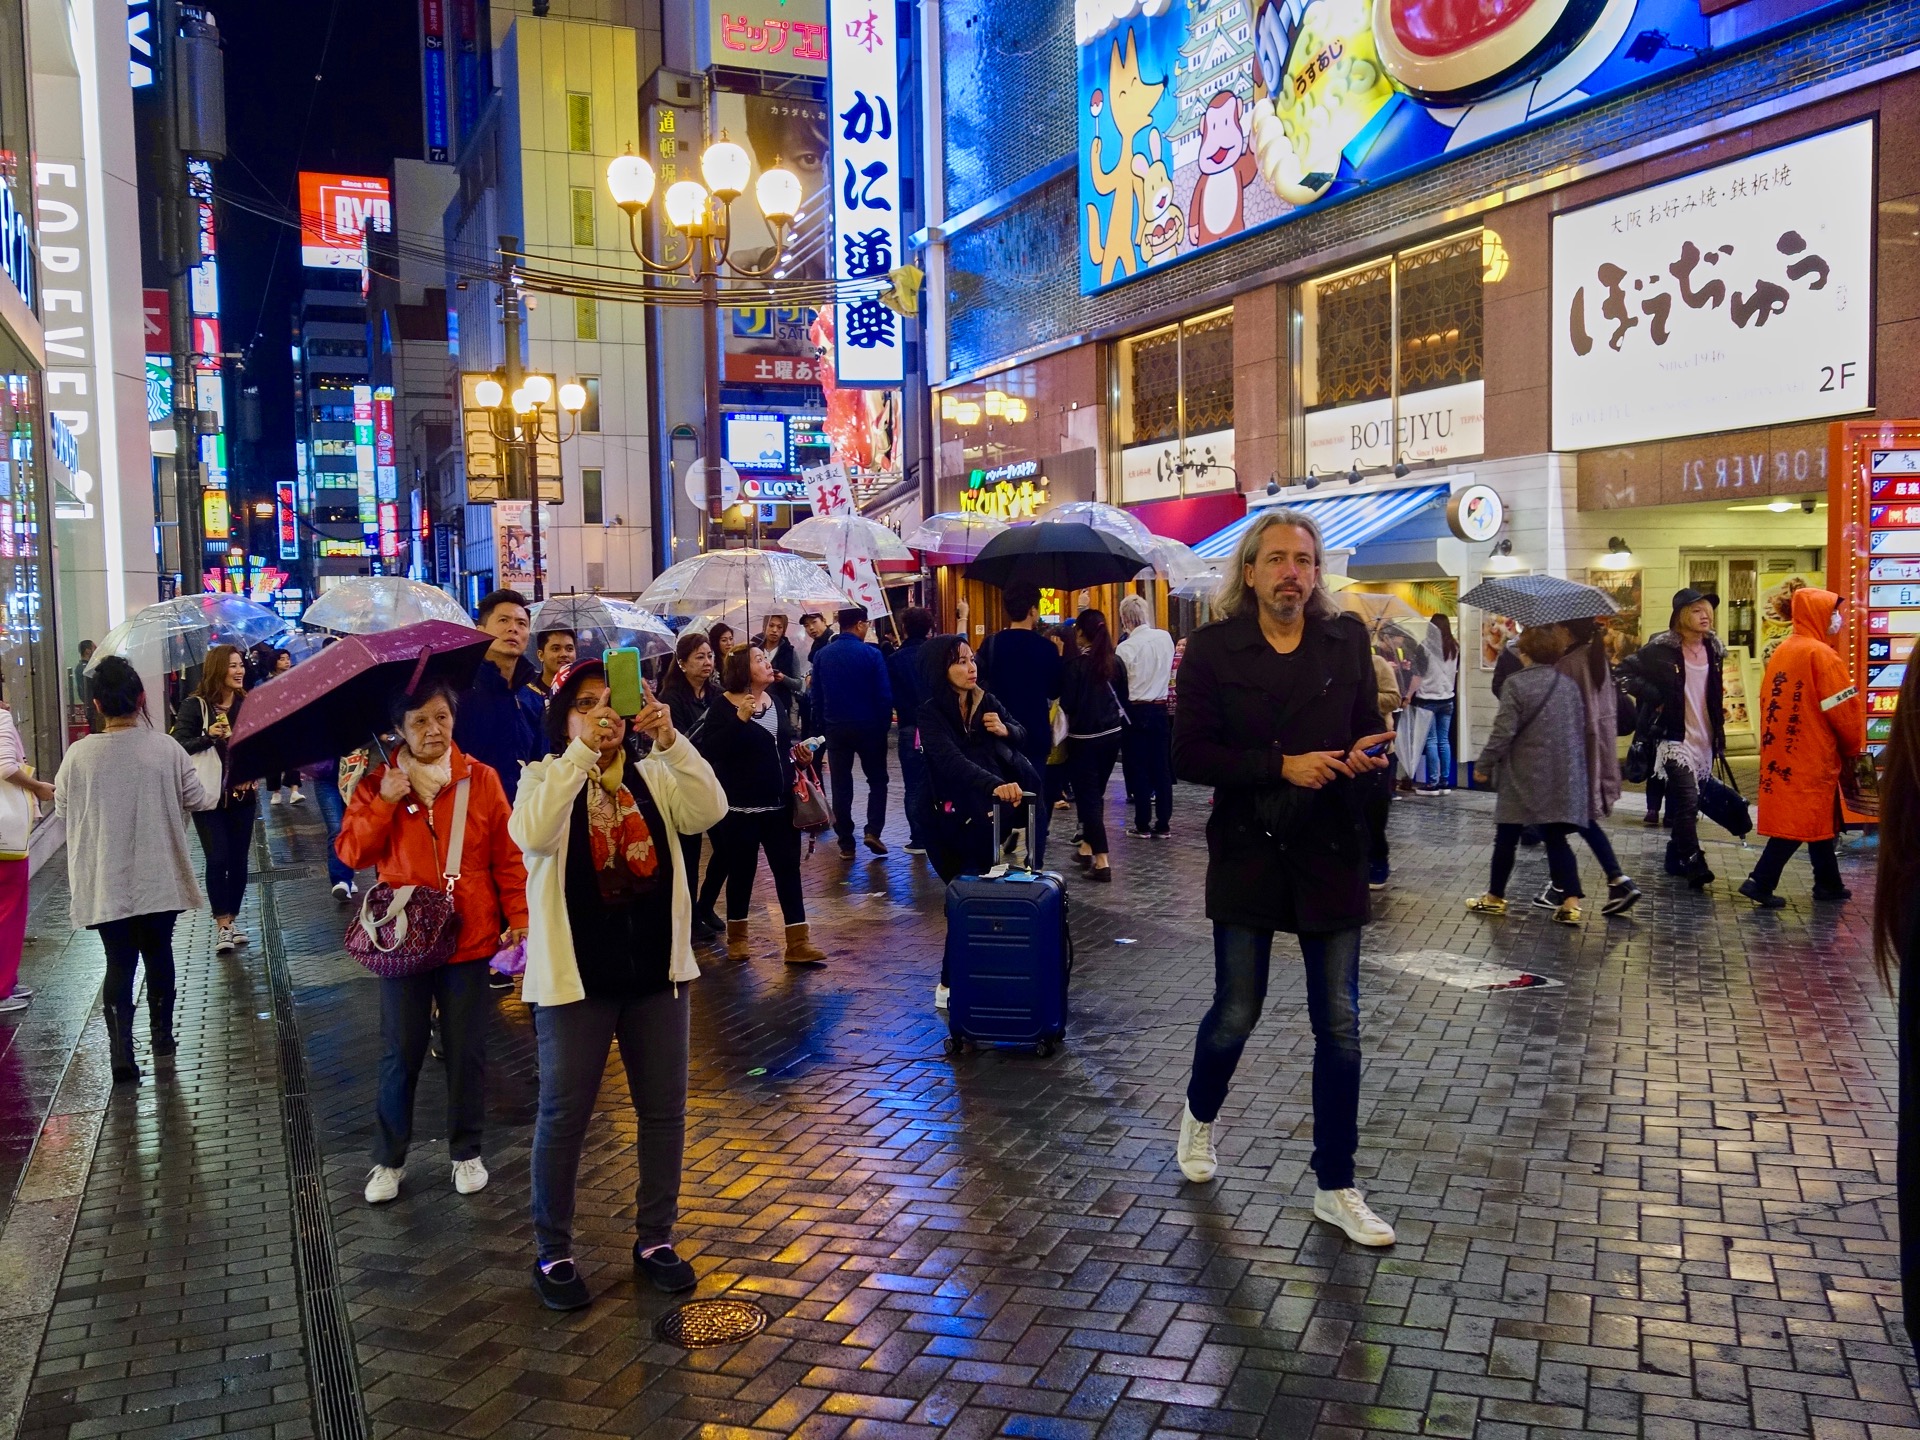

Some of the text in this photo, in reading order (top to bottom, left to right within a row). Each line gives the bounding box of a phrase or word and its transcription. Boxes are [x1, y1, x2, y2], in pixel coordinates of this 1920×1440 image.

[127, 0, 152, 87] VA
[846, 9, 883, 53] 味
[1296, 39, 1343, 94] うすあじ
[658, 110, 679, 288] 道頓堀光ビル
[1611, 209, 1642, 234] 大阪
[1570, 230, 1830, 356] ぼてぢゅう
[1819, 362, 1856, 392] 2F
[1350, 409, 1453, 450] BOTEJYU
[1431, 445, 1447, 455] 1946
[1873, 481, 1888, 492] 8F
[1871, 507, 1884, 517] 7F
[1871, 617, 1887, 629] 3F
[1869, 644, 1888, 657] 3F
[1868, 669, 1880, 677] 2F
